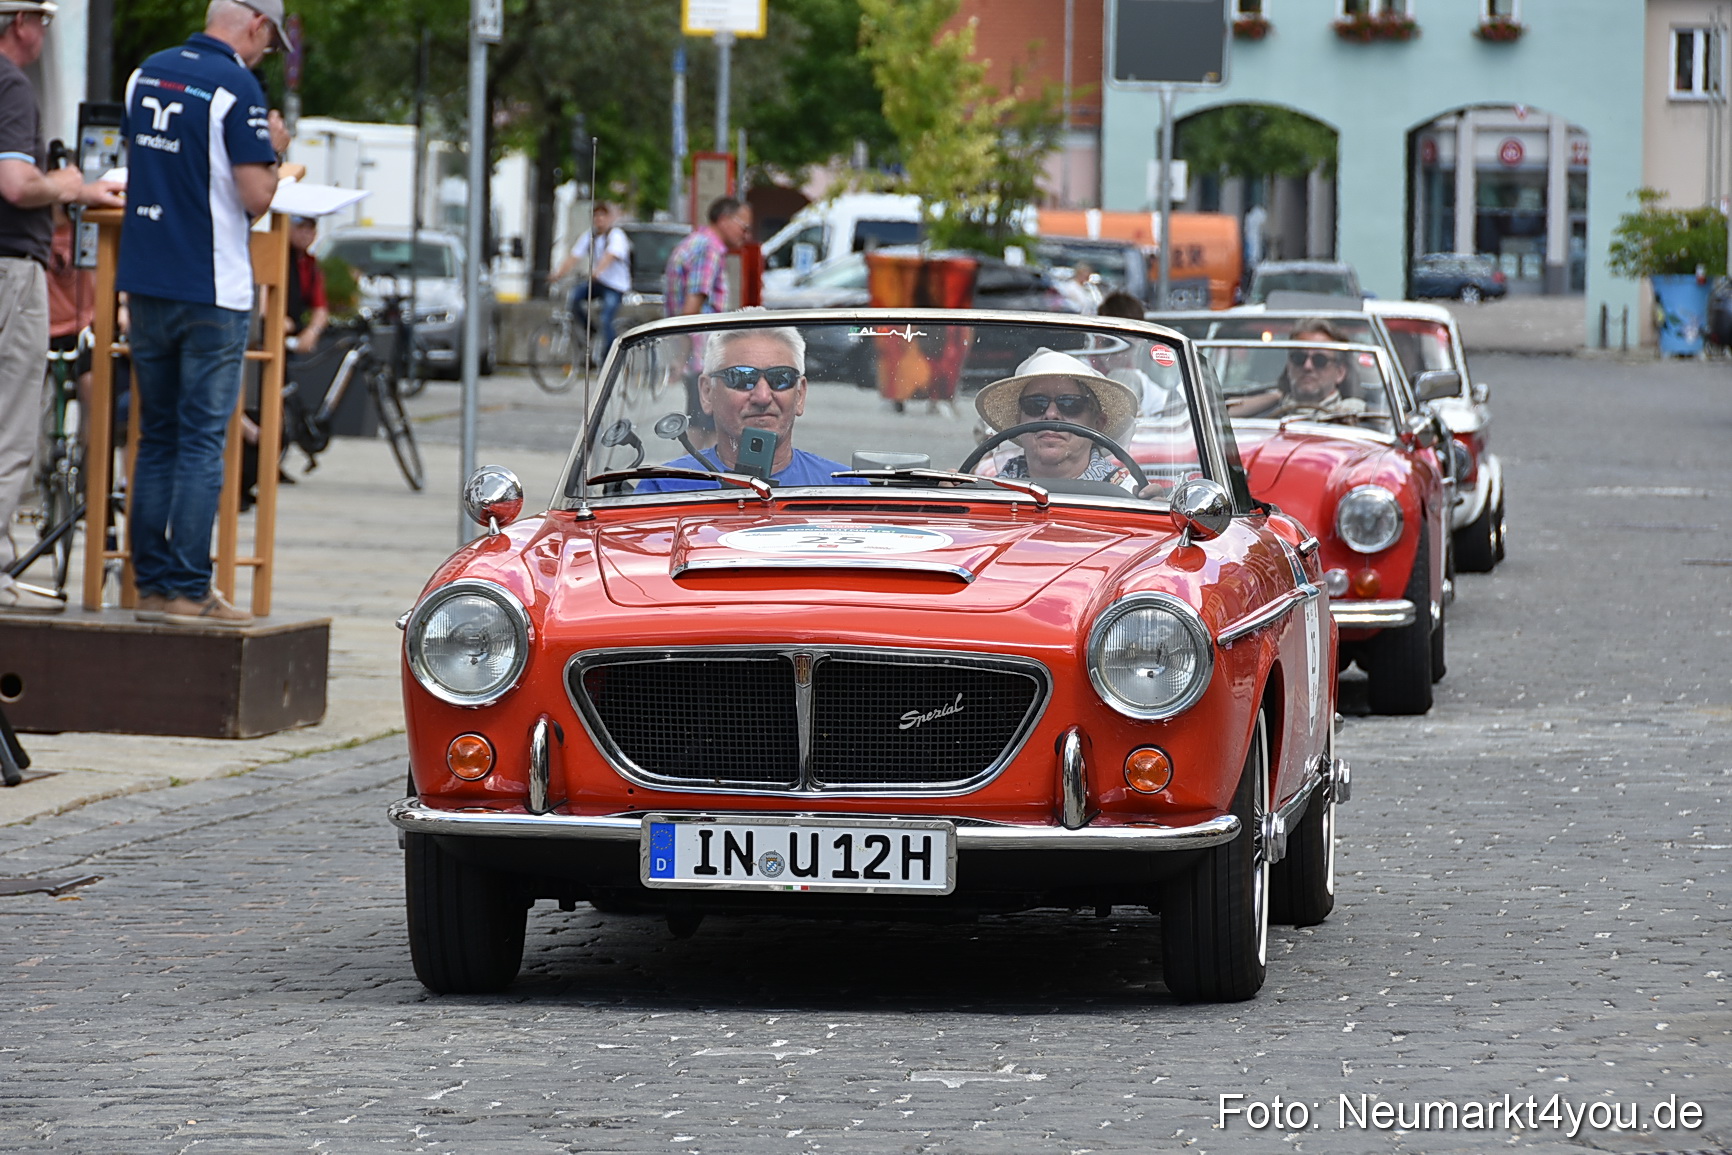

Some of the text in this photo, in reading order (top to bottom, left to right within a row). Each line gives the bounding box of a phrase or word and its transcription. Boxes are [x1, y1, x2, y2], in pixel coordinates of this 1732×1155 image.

[136, 134, 180, 152] randstad
[797, 536, 866, 544] 25
[898, 692, 964, 730] Spezial
[694, 829, 753, 876] IN
[656, 857, 667, 871] D
